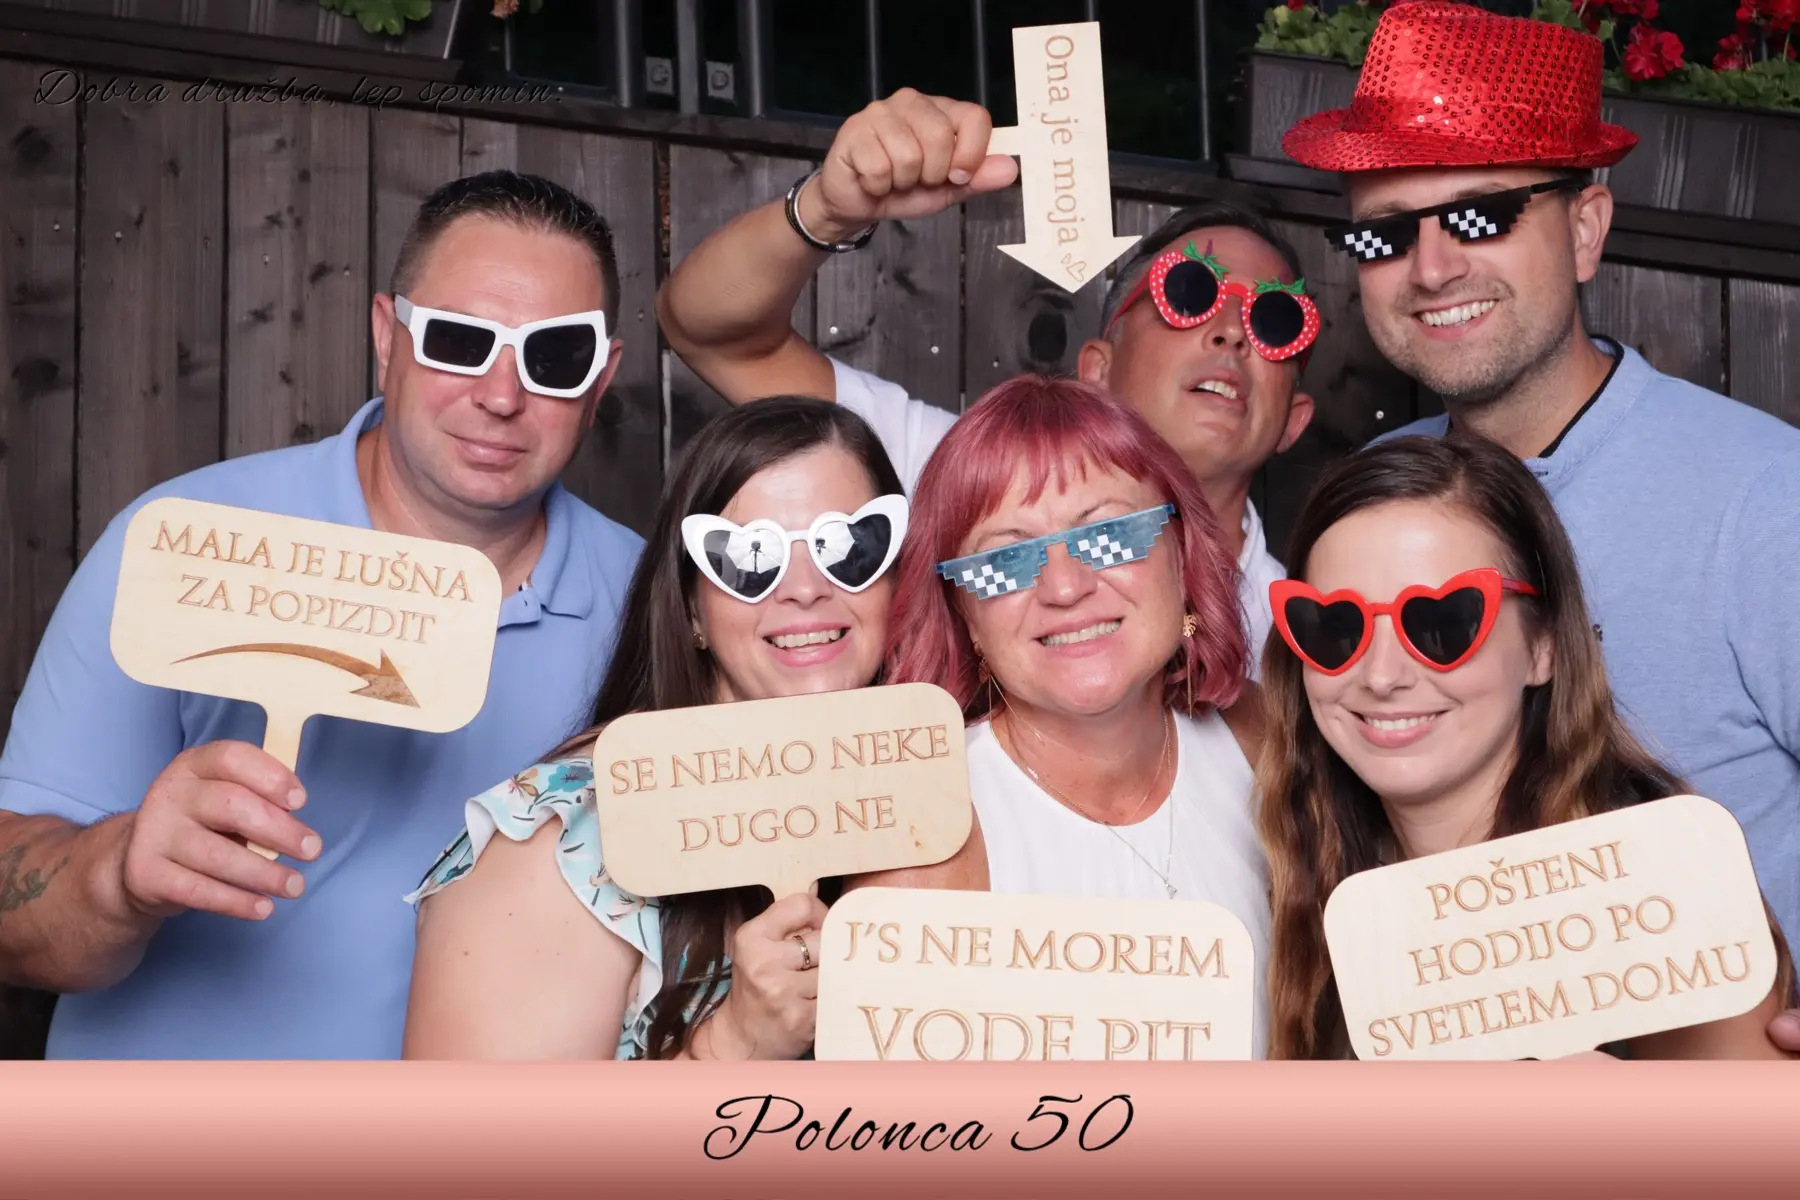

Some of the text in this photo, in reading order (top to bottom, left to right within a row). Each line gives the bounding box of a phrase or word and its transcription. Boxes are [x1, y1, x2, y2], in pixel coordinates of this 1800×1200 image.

[1041, 35, 1085, 246] Ona je moja
[150, 519, 474, 603] MALA JE LUŠNA
[176, 572, 437, 645] ZA POPIZDIT
[608, 723, 952, 796] SE NEMO NEKE
[678, 794, 898, 852] DUGO NE
[1426, 841, 1631, 922] POŠTENI
[915, 924, 993, 967] NE
[1005, 929, 1230, 980] MOREM
[1408, 895, 1677, 987] HODIJO PO
[1367, 940, 1754, 1058] SVETLEM DOMU
[1096, 1018, 1212, 1061] PIT
